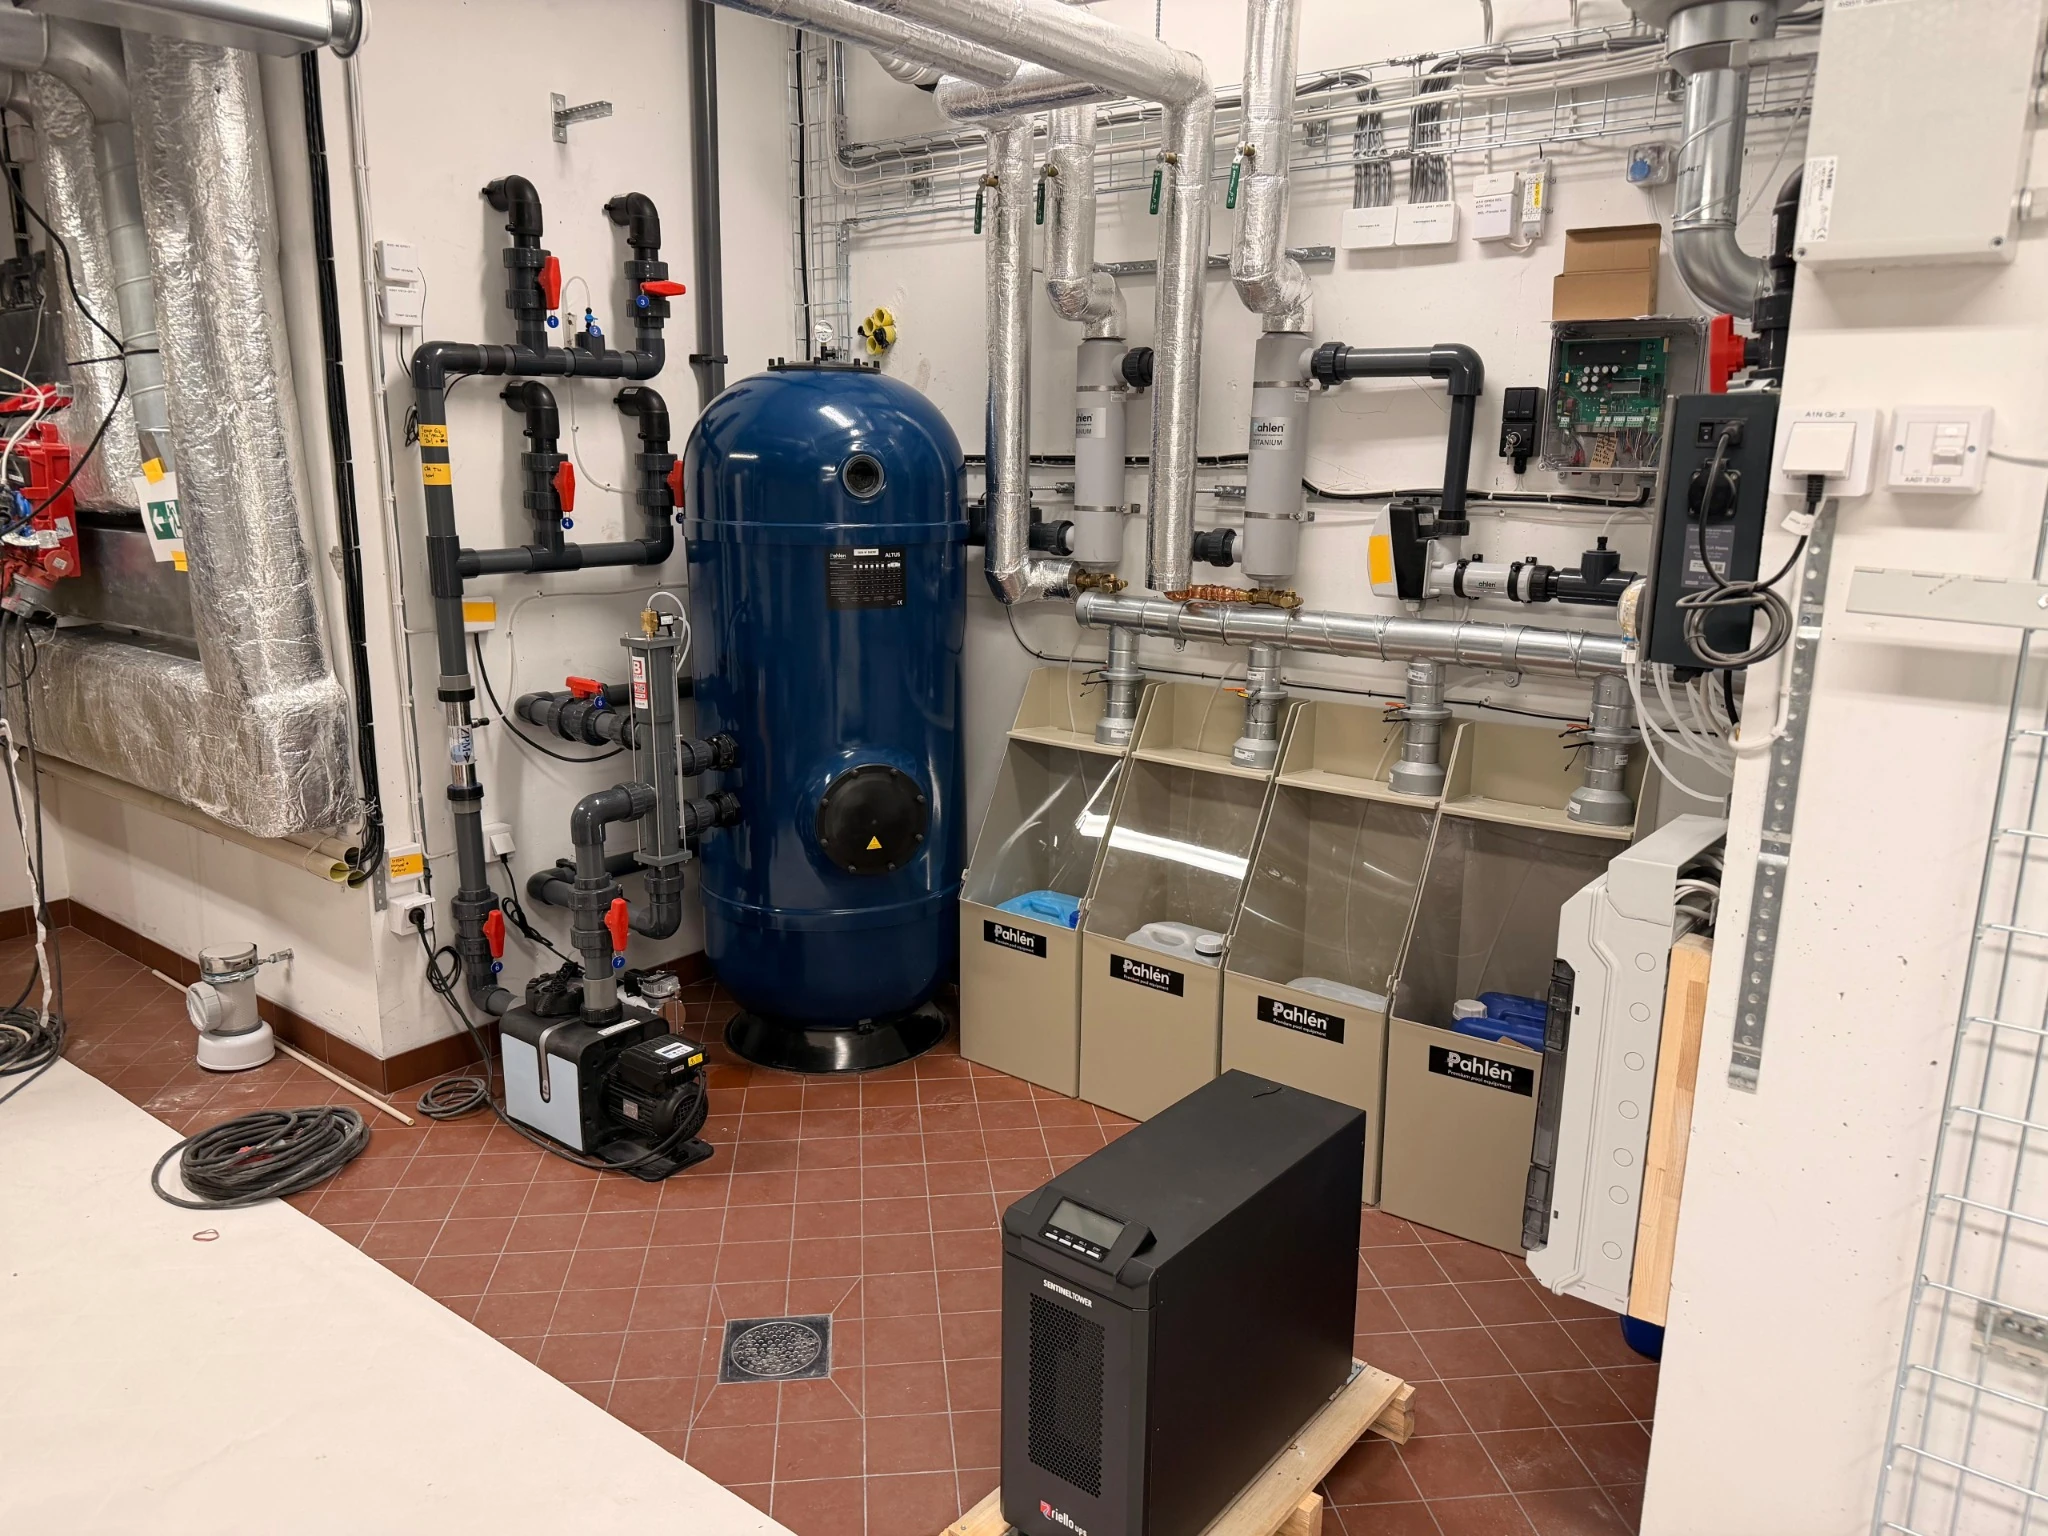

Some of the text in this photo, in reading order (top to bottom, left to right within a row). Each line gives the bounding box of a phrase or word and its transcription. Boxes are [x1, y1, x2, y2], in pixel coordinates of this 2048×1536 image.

[994, 924, 1035, 948] Pahlén
[1122, 959, 1169, 985] Pahlén
[1272, 1001, 1327, 1031] Pahlén
[1446, 1051, 1512, 1083] Pahlén
[1447, 1069, 1471, 1080] Premium
[1483, 1078, 1512, 1090] equipment
[1051, 1507, 1074, 1530] riello
